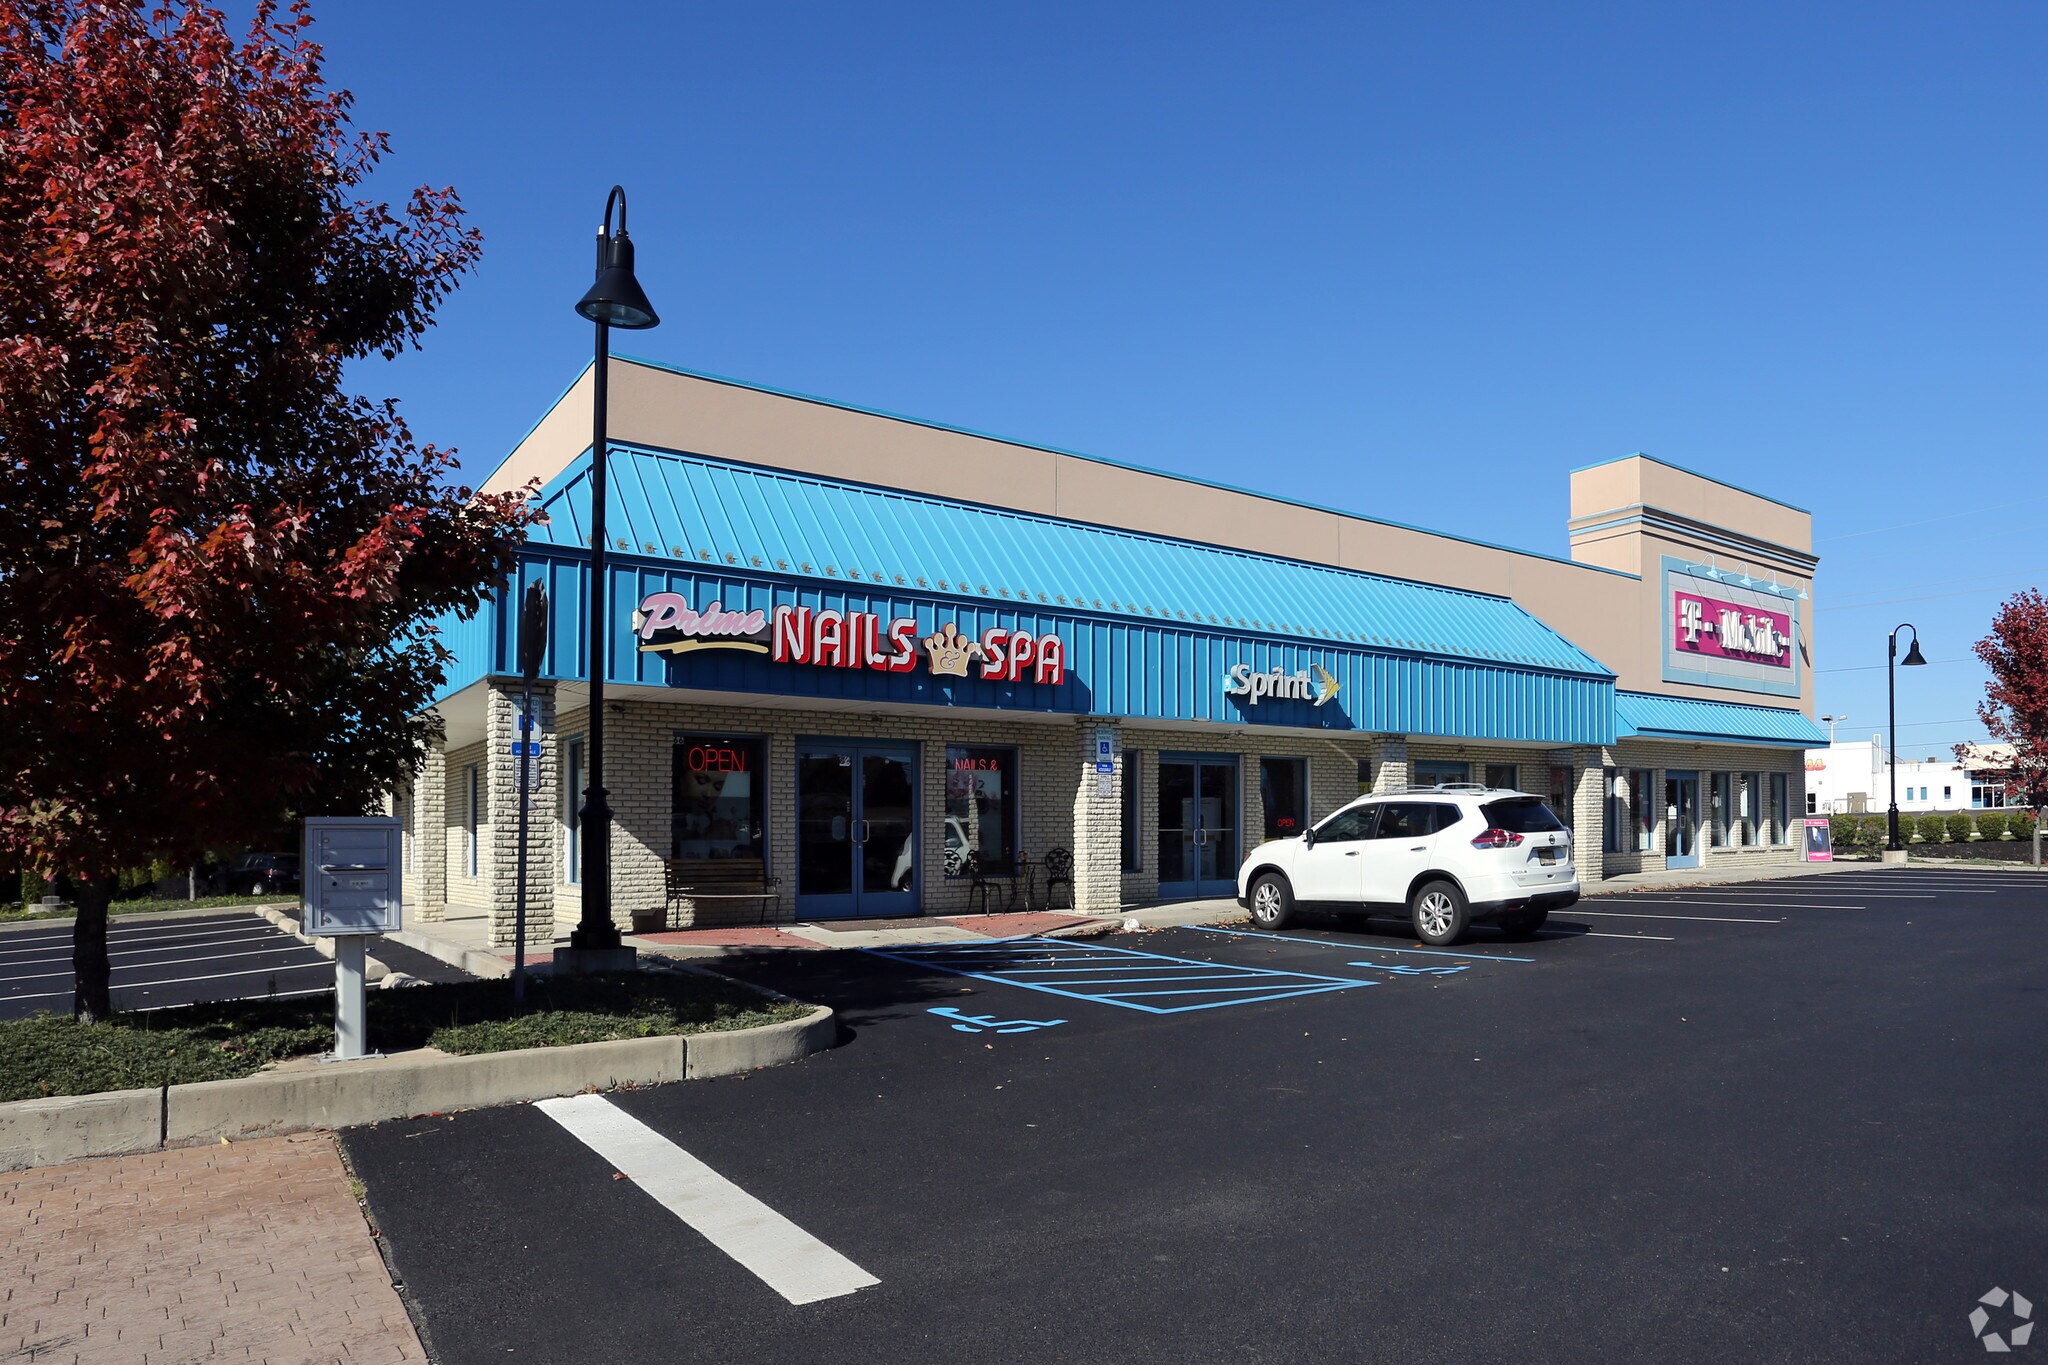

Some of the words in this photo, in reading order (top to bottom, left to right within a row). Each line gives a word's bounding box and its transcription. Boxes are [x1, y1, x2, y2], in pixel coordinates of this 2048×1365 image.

[639, 592, 766, 640] Prime
[772, 603, 917, 673] NAILS
[940, 651, 961, 670] &
[980, 628, 1064, 685] SPA
[1230, 663, 1312, 705] Sprint
[688, 747, 745, 772] OPEN
[955, 758, 986, 771] NAILS
[990, 758, 998, 771] &
[1277, 817, 1295, 827] OPEN
